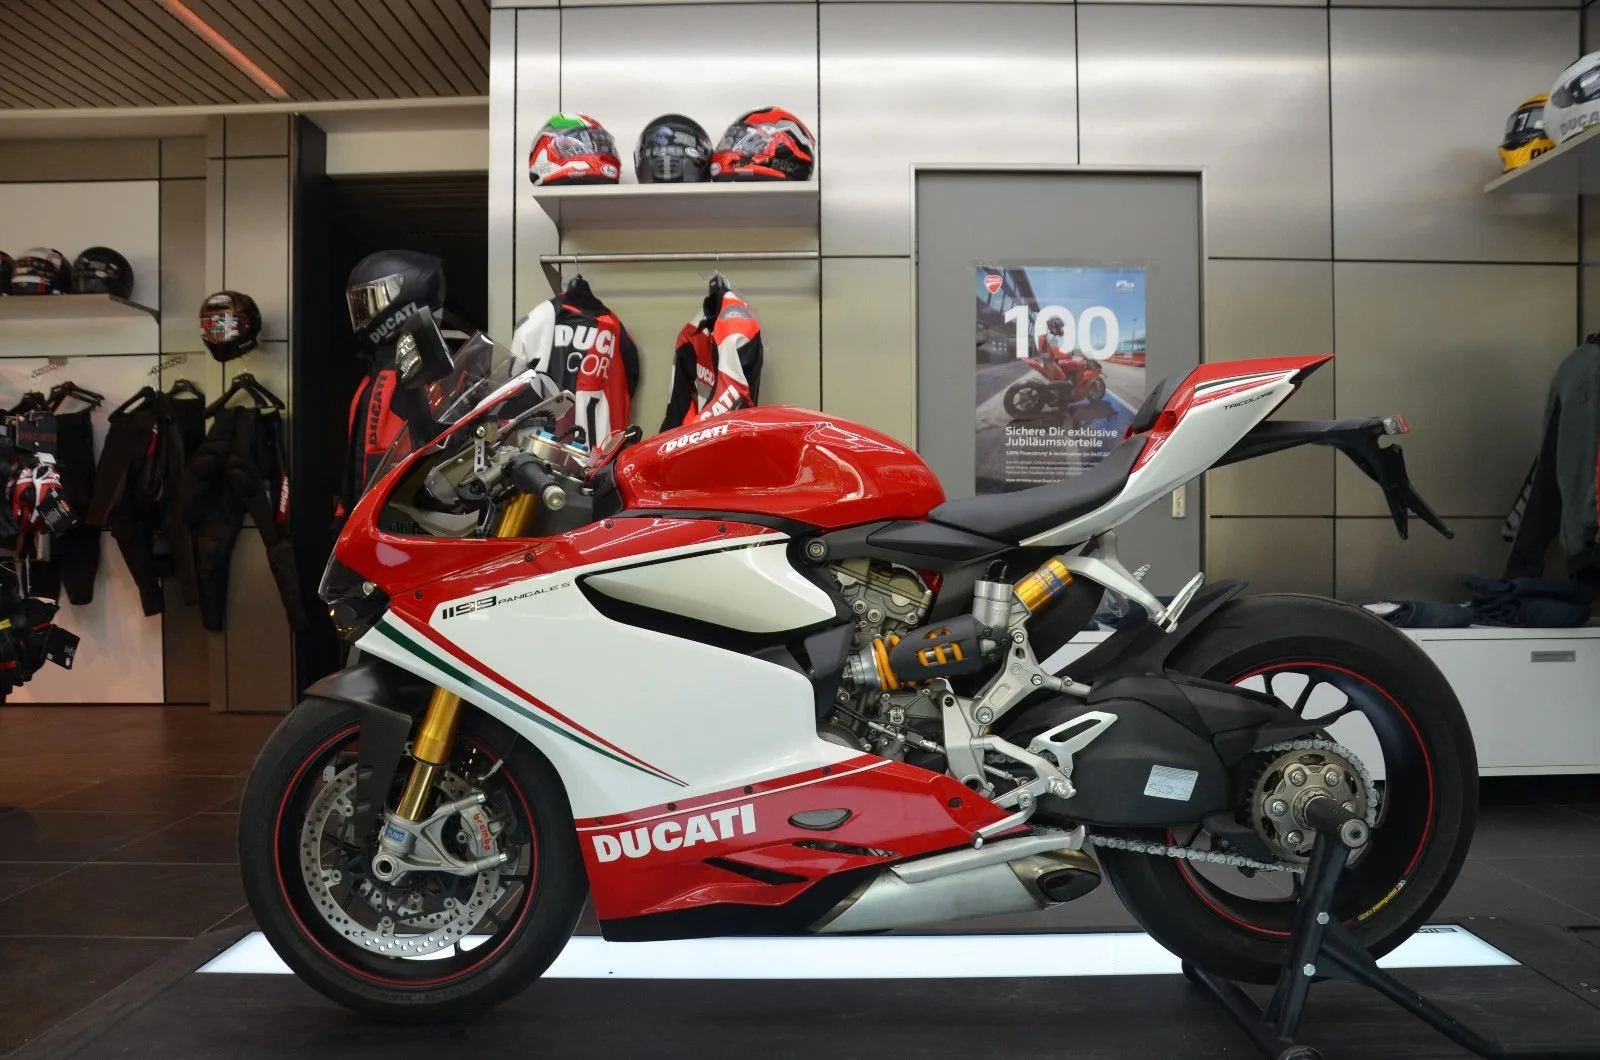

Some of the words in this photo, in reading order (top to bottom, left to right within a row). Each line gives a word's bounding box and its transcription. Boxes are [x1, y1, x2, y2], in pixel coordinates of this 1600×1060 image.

[369, 301, 418, 344] DUCATI
[1004, 305, 1119, 360] 100
[1223, 390, 1275, 410] TRICOLORE
[665, 424, 728, 453] DUCATI
[1005, 426, 1046, 436] Sichere
[1048, 426, 1065, 437] Dir
[1067, 427, 1118, 438] exklusive
[1005, 436, 1103, 447] Jubiläumsvorteile
[442, 596, 497, 620] 1199
[498, 584, 559, 605] PANIGALE
[560, 581, 571, 589] S
[473, 812, 491, 851] brembo
[592, 803, 756, 863] DUCATI
